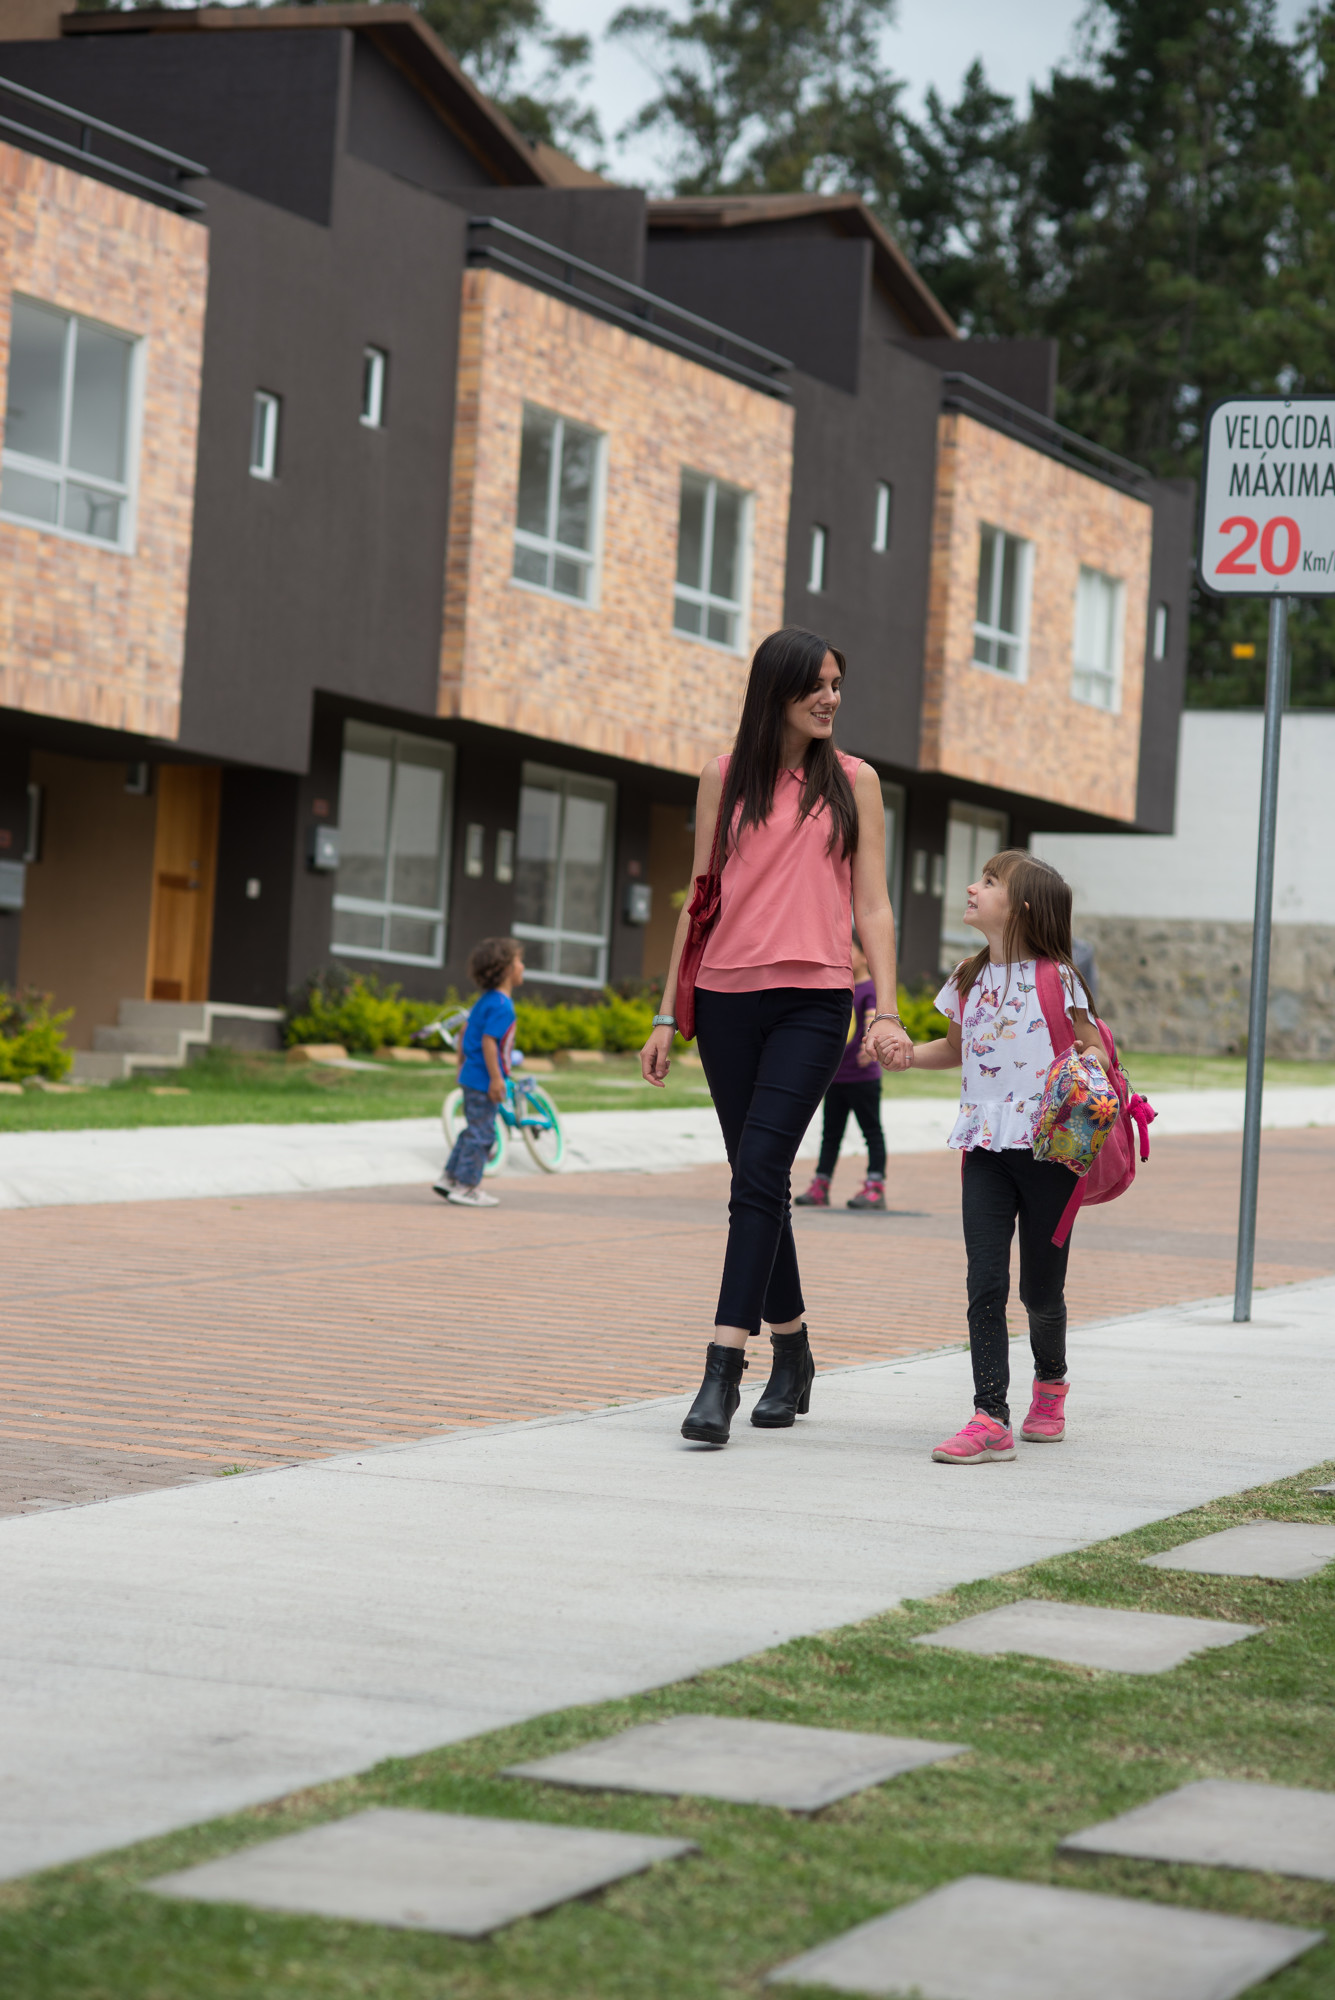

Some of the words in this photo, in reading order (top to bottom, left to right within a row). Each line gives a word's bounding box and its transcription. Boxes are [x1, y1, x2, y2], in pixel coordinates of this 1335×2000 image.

[1225, 414, 1335, 449] VELOCIDA
[1228, 451, 1335, 497] MÁXIMA
[1214, 515, 1302, 576] 20
[1302, 550, 1335, 574] Km/
